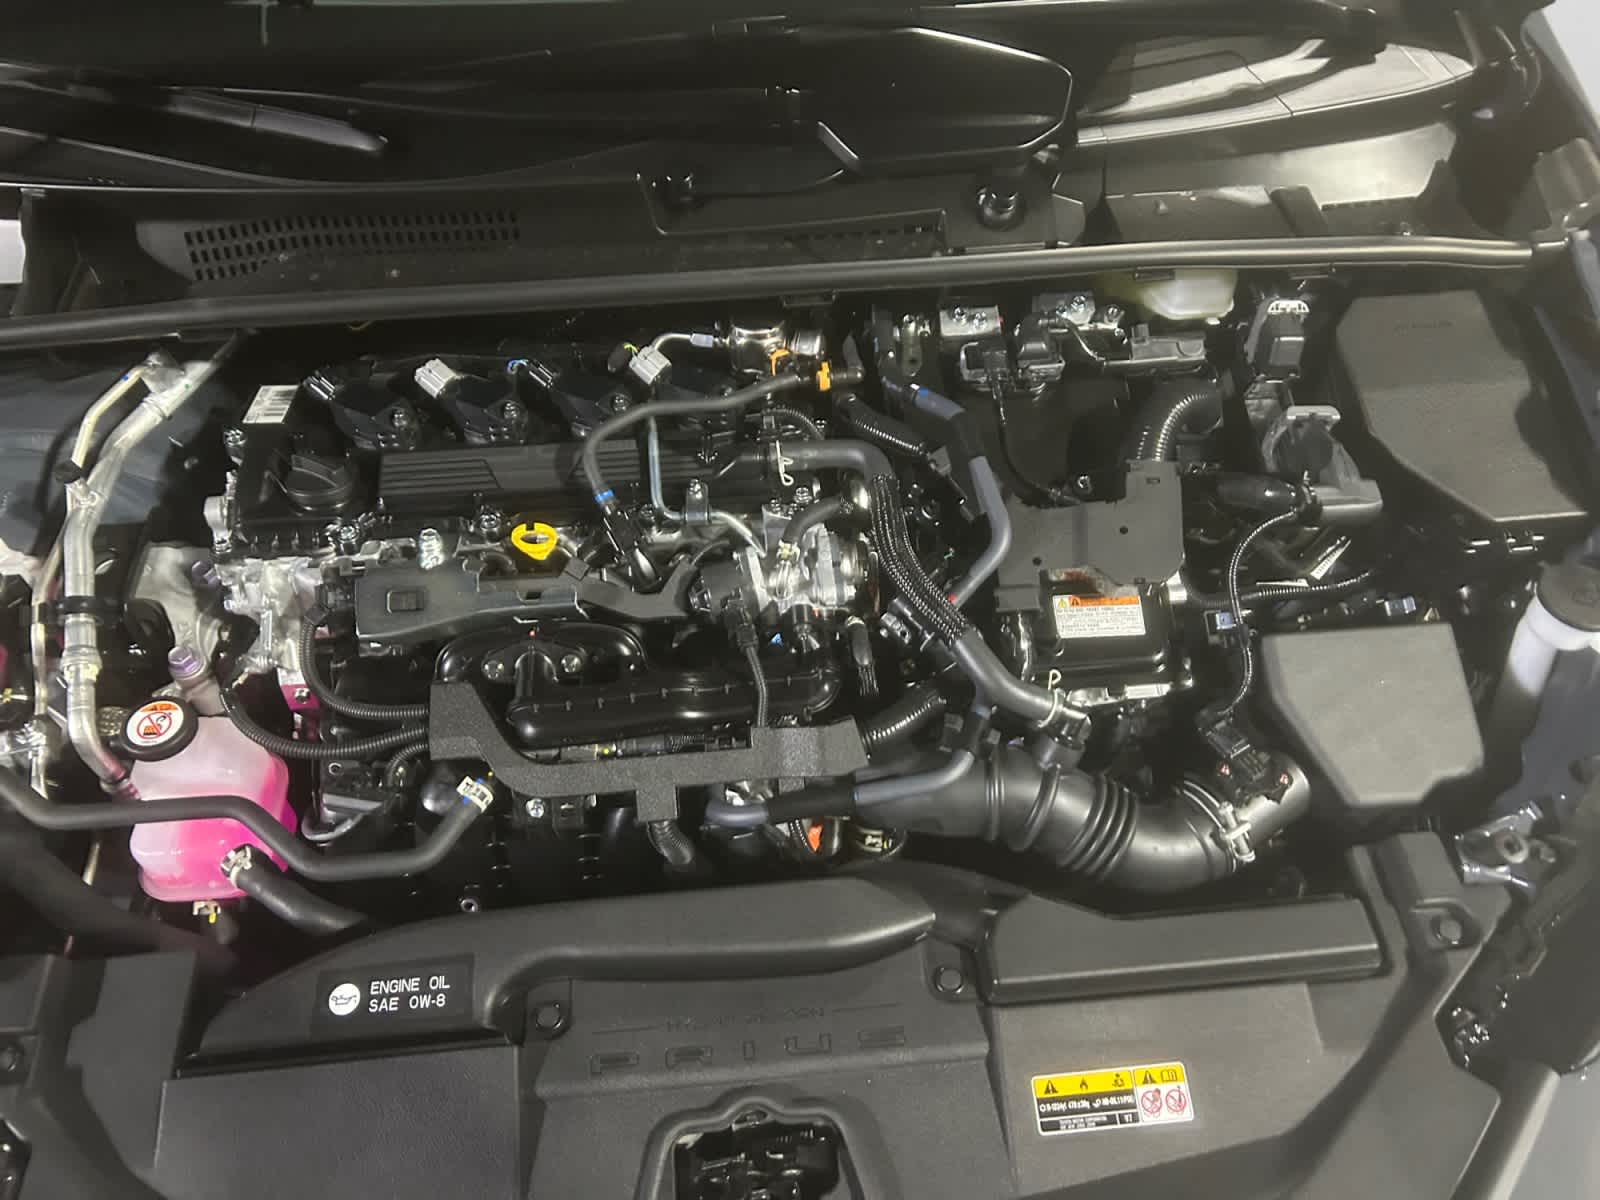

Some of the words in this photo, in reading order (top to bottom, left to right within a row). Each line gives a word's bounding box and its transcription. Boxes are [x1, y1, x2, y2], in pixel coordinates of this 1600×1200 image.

[370, 977, 420, 995] ENGINE
[428, 975, 451, 990] OIL
[368, 997, 399, 1012] SAE
[408, 993, 446, 1009] 0W-8
